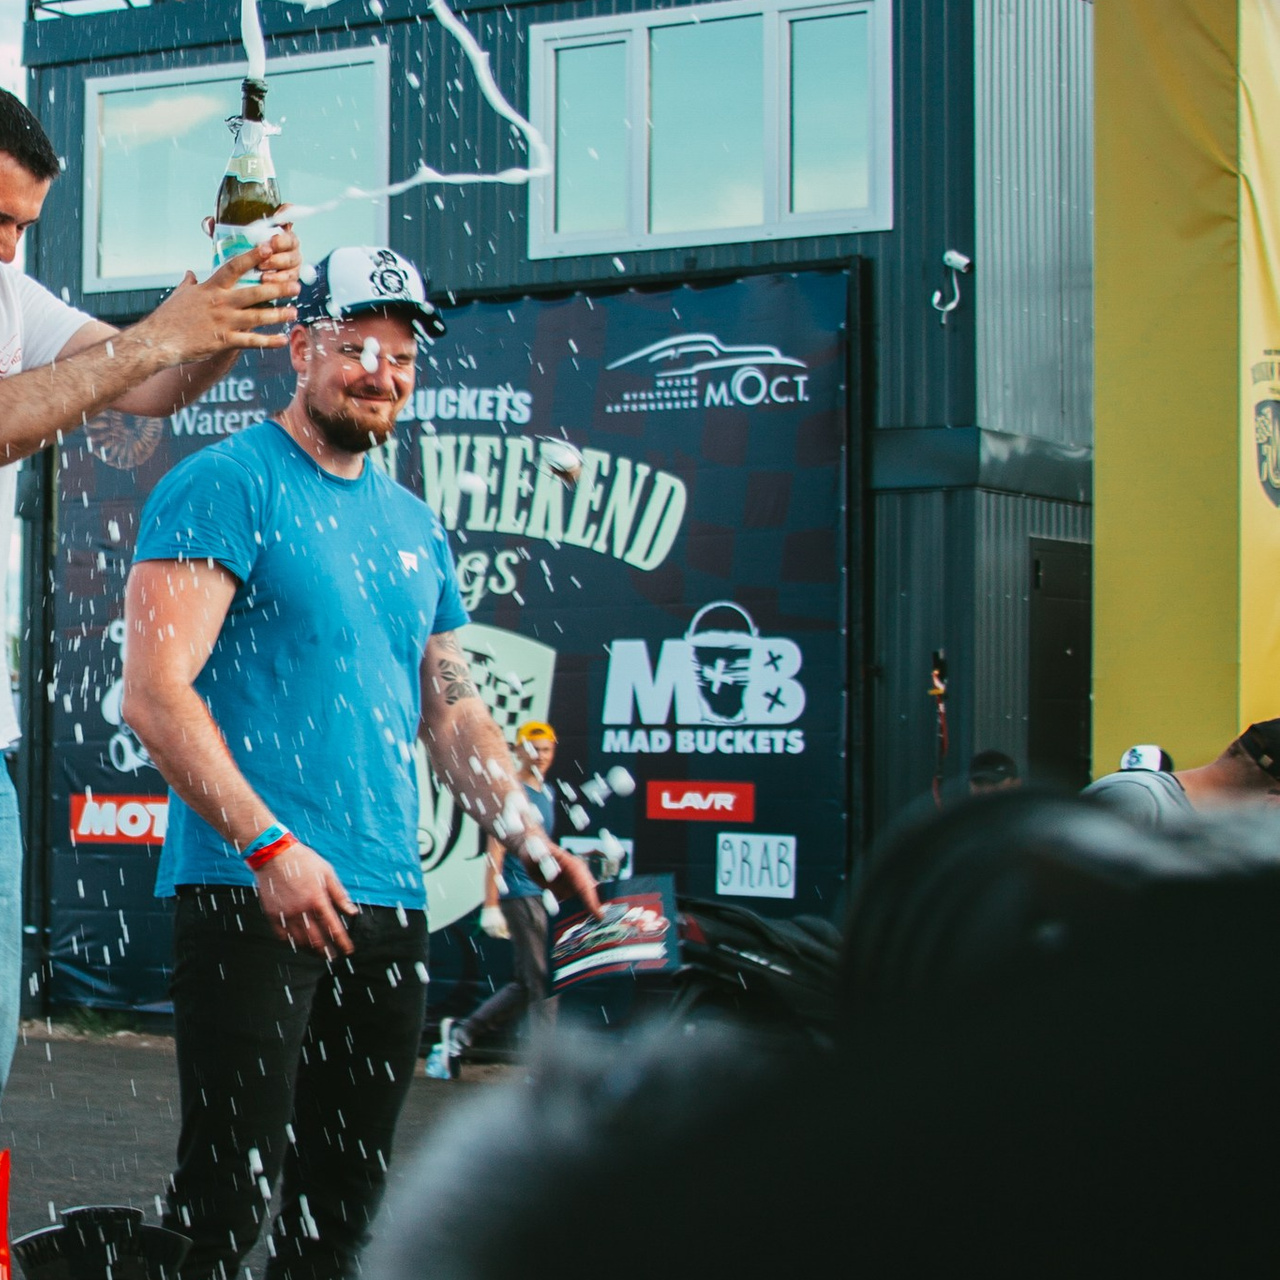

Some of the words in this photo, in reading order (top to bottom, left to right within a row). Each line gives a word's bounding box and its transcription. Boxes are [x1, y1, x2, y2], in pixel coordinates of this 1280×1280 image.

[199, 377, 255, 403] ite
[420, 435, 687, 571] WEEKEND
[602, 729, 669, 754] MAD
[676, 729, 806, 755] BUCKETS
[661, 791, 737, 811] LAVR
[77, 801, 169, 838] MOT
[720, 838, 792, 889] GRAB
